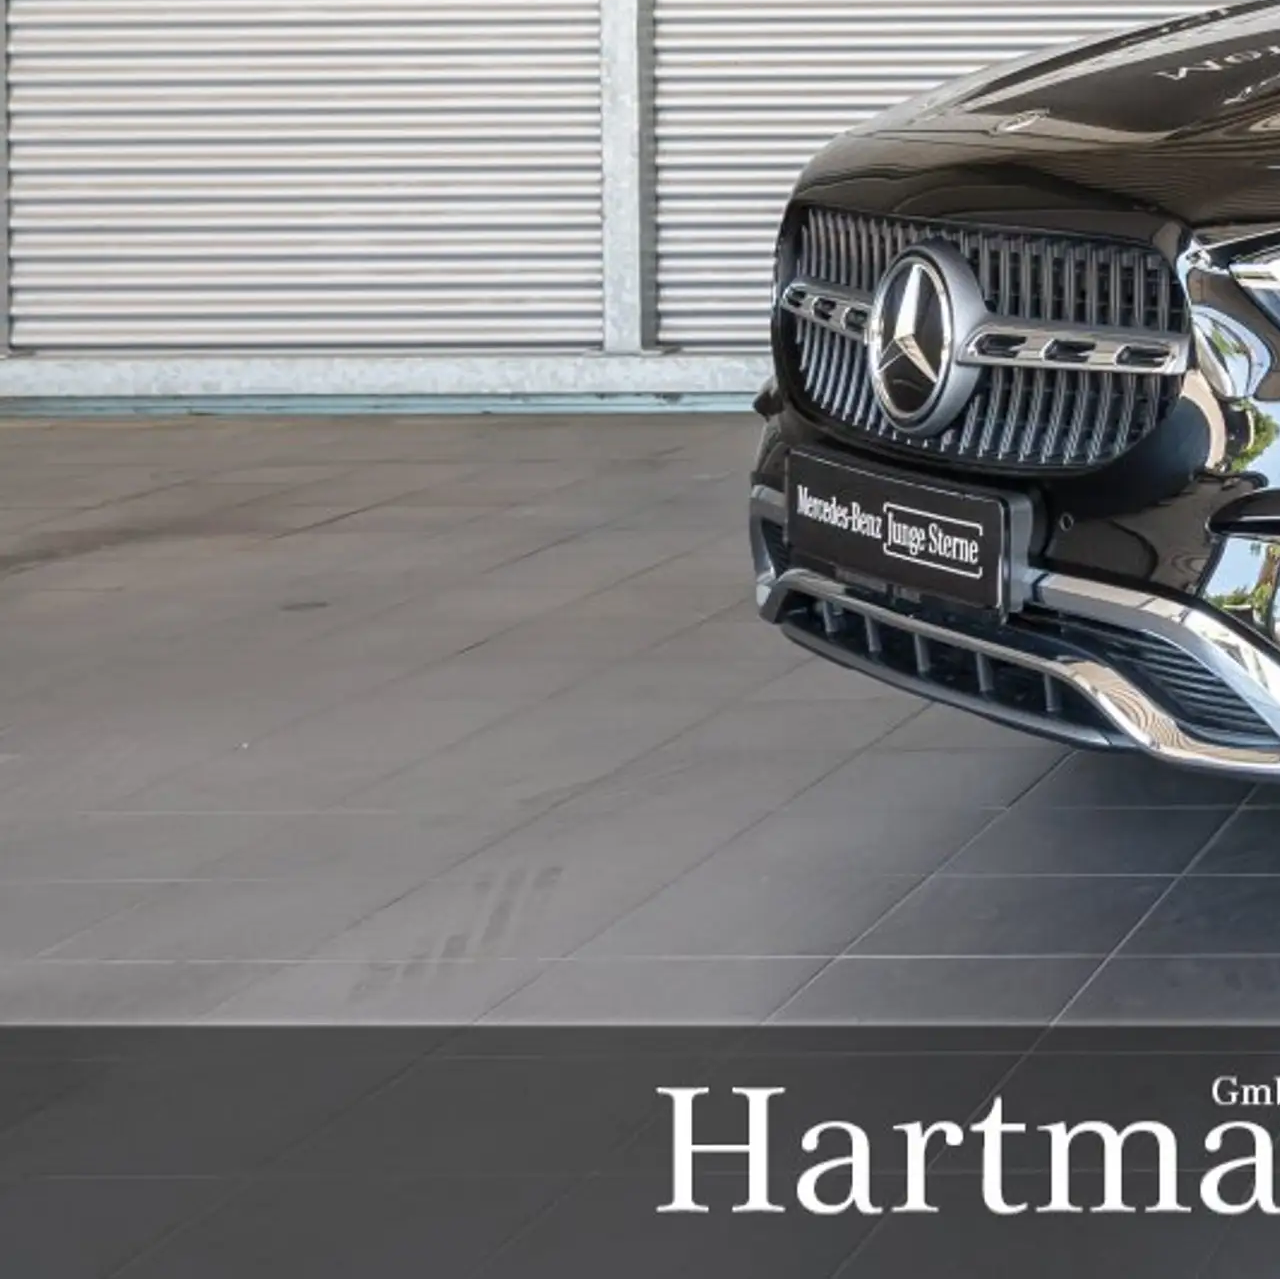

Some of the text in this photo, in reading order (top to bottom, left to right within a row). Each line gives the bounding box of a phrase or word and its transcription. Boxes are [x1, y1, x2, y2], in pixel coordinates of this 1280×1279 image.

[797, 484, 882, 539] Mercedes-Benz
[886, 511, 979, 564] Junge Sterne
